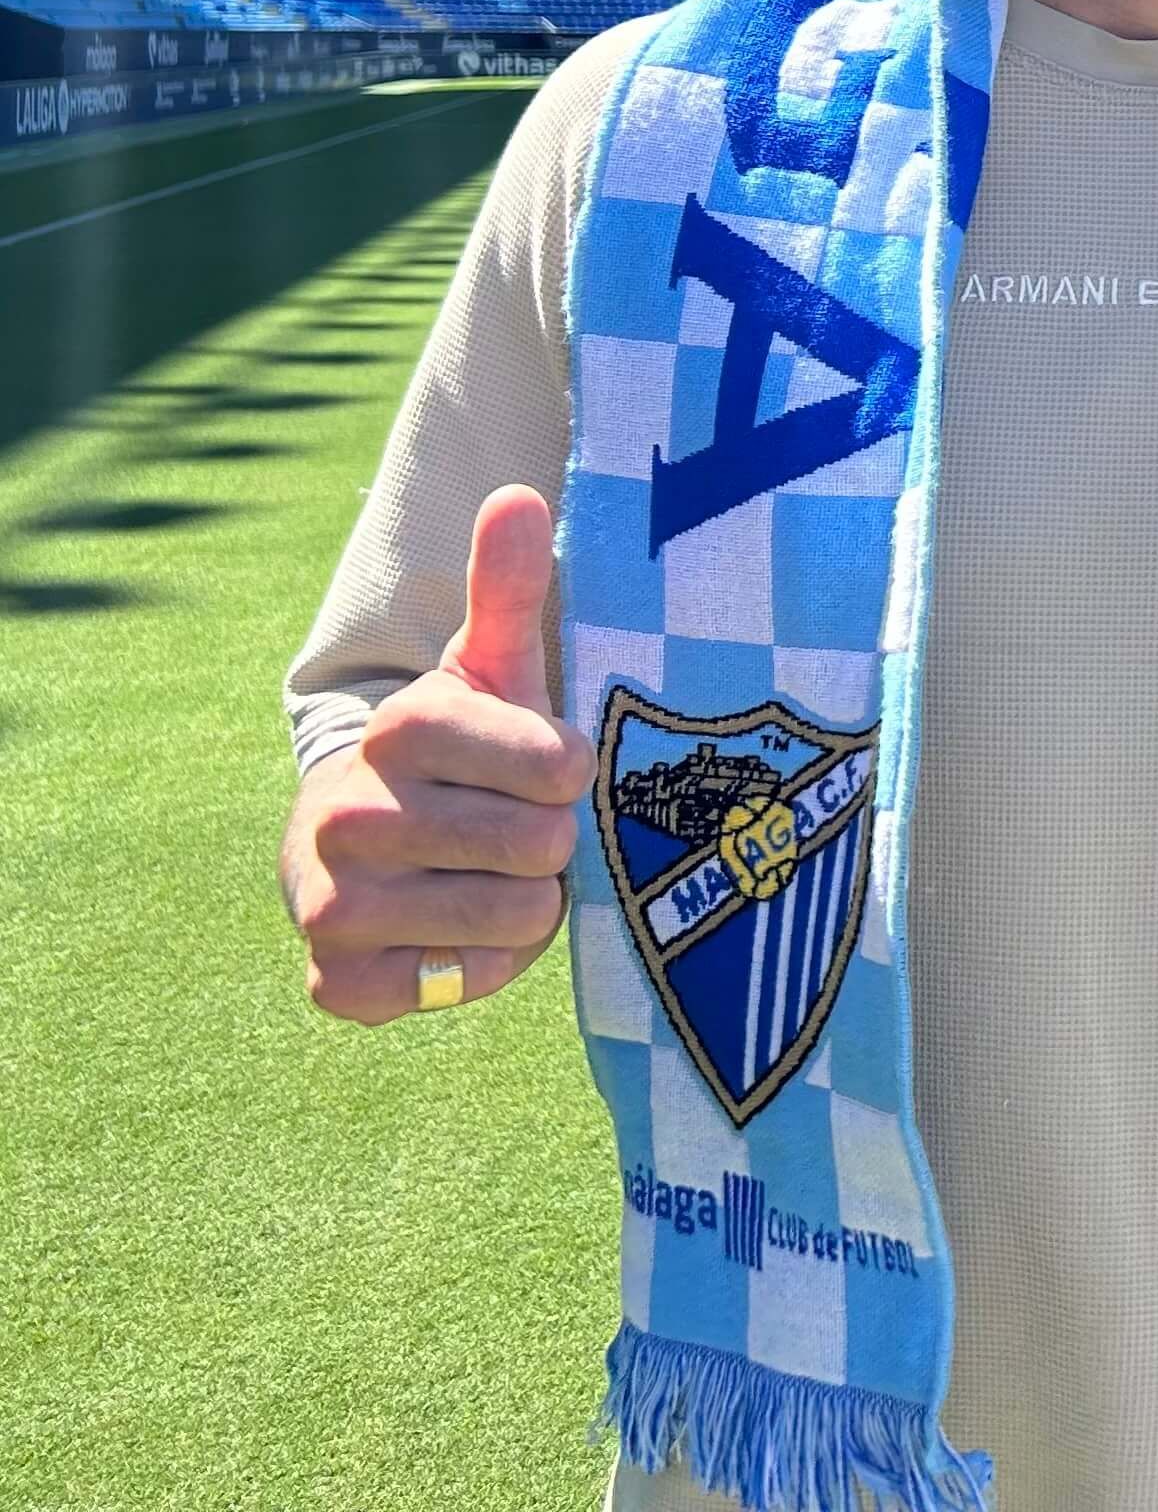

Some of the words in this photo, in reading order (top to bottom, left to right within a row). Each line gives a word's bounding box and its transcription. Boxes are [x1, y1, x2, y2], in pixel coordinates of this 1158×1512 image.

[15, 87, 58, 135] LALIGA
[961, 273, 1118, 305] ARMANI
[759, 734, 794, 753] TM
[768, 1206, 809, 1255] CLUB
[812, 1222, 839, 1262] de
